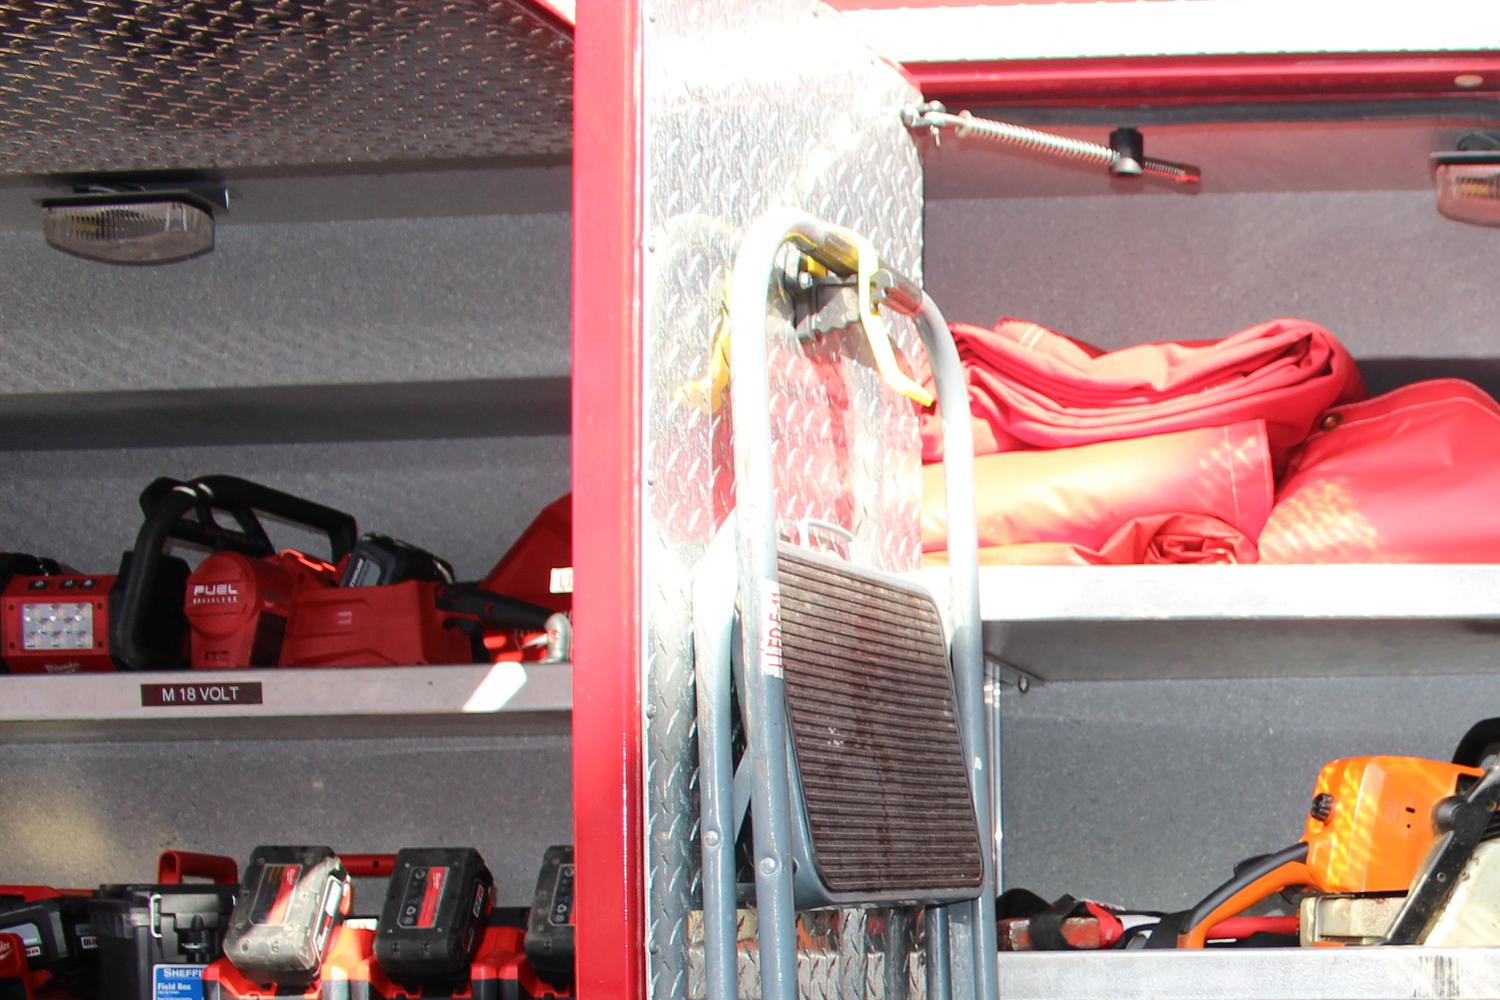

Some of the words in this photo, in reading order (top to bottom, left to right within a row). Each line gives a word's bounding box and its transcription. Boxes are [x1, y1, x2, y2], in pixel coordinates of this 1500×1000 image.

[194, 584, 238, 596] FUEL
[162, 688, 175, 701] M
[180, 687, 196, 701] 18
[199, 686, 239, 701] VOLT
